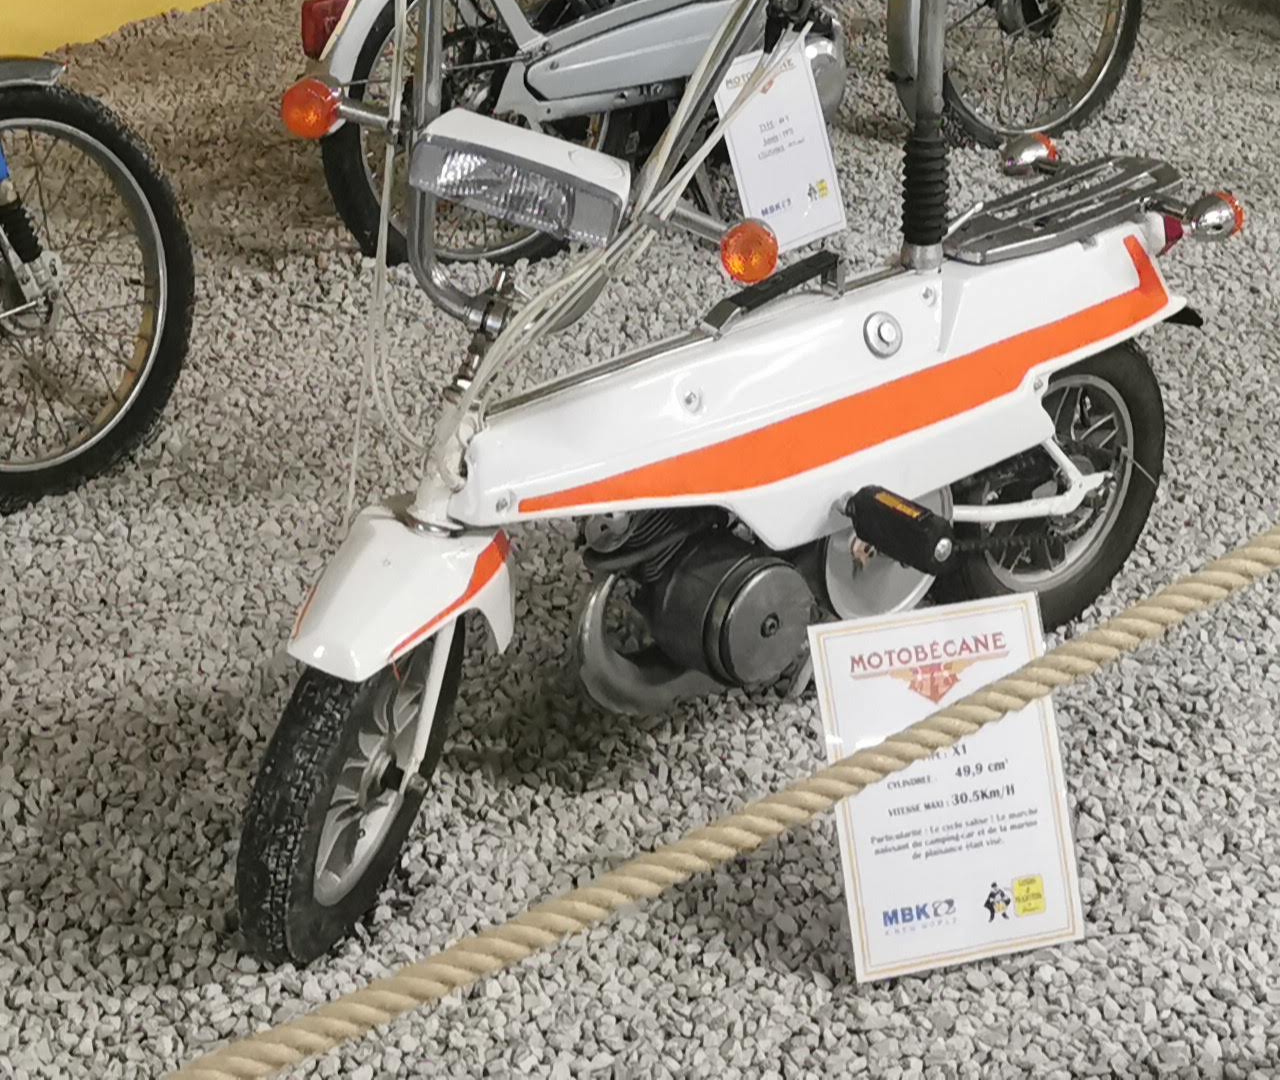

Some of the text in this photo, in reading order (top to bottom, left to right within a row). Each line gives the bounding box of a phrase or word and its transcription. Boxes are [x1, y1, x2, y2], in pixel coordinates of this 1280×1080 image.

[850, 631, 1007, 673] MOTOBÉCANE
[954, 762, 984, 779] 49,9
[951, 782, 1016, 807] 30.5Km/H
[882, 903, 930, 927] MBK
